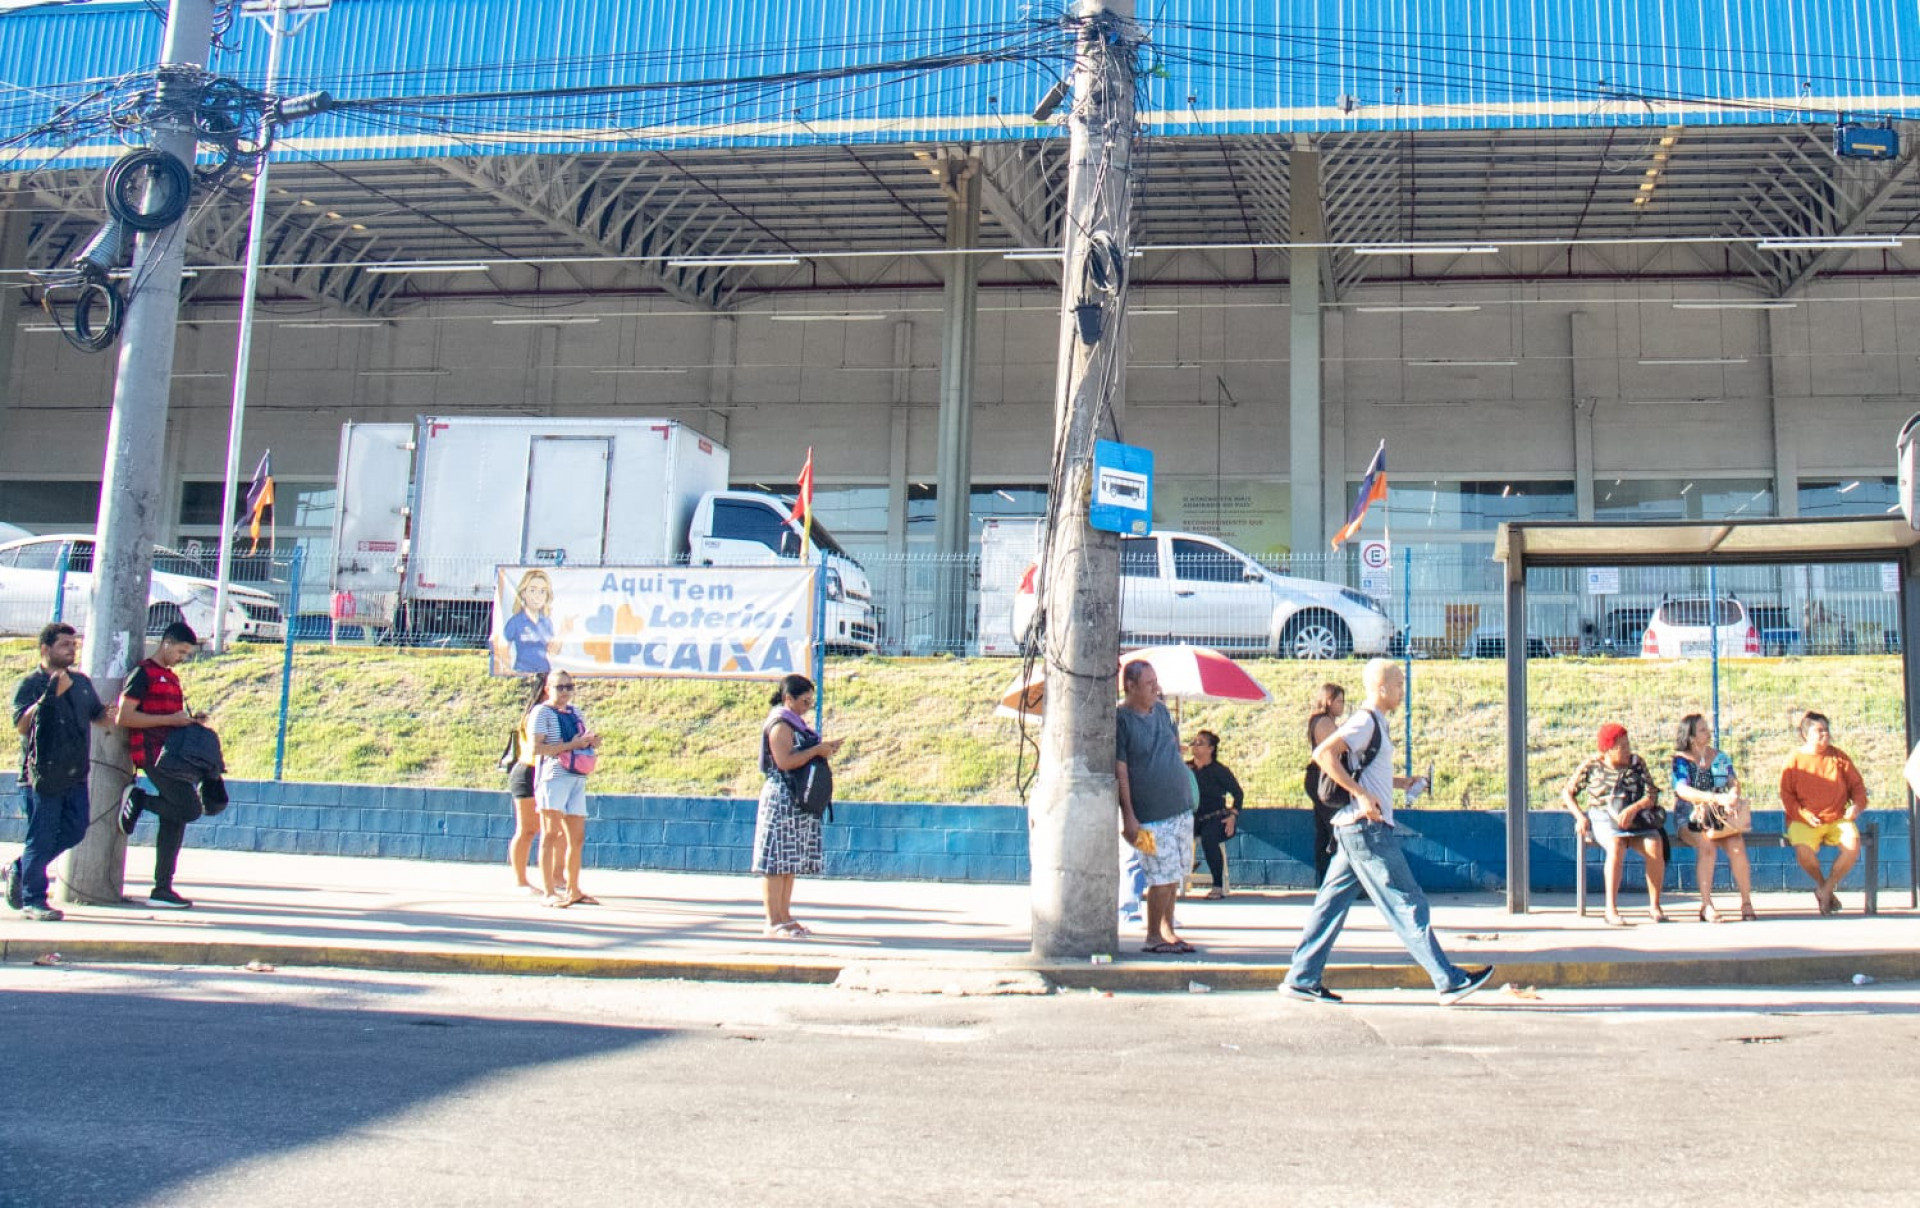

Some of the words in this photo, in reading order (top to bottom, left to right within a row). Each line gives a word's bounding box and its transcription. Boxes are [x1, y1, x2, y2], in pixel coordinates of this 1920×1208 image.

[1371, 549, 1381, 563] E
[601, 572, 663, 597] Aqui
[668, 578, 733, 600] Tem
[648, 603, 793, 629] Loterias
[643, 637, 793, 672] CAIXA
